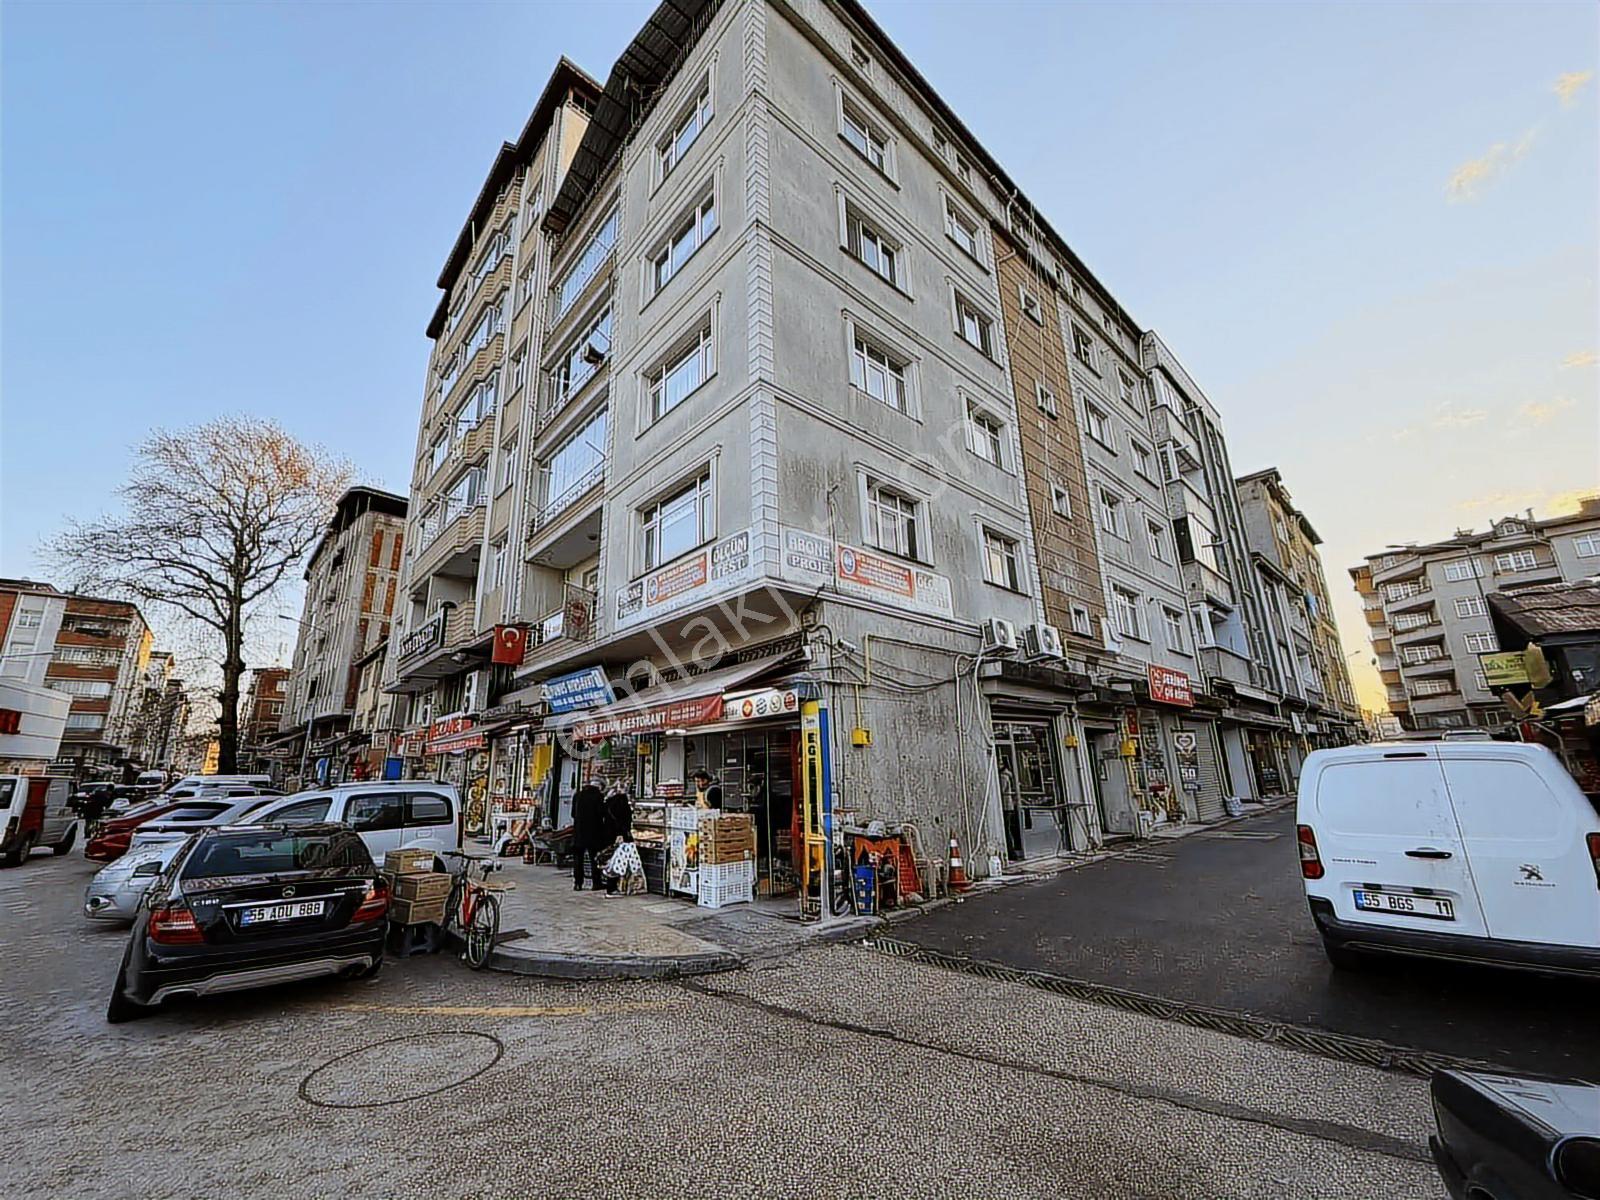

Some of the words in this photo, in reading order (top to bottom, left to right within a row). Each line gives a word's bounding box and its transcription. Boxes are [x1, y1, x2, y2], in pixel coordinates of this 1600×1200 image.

[1363, 893, 1381, 907] 55
[1387, 895, 1415, 911] BGS
[1435, 901, 1451, 915] 11
